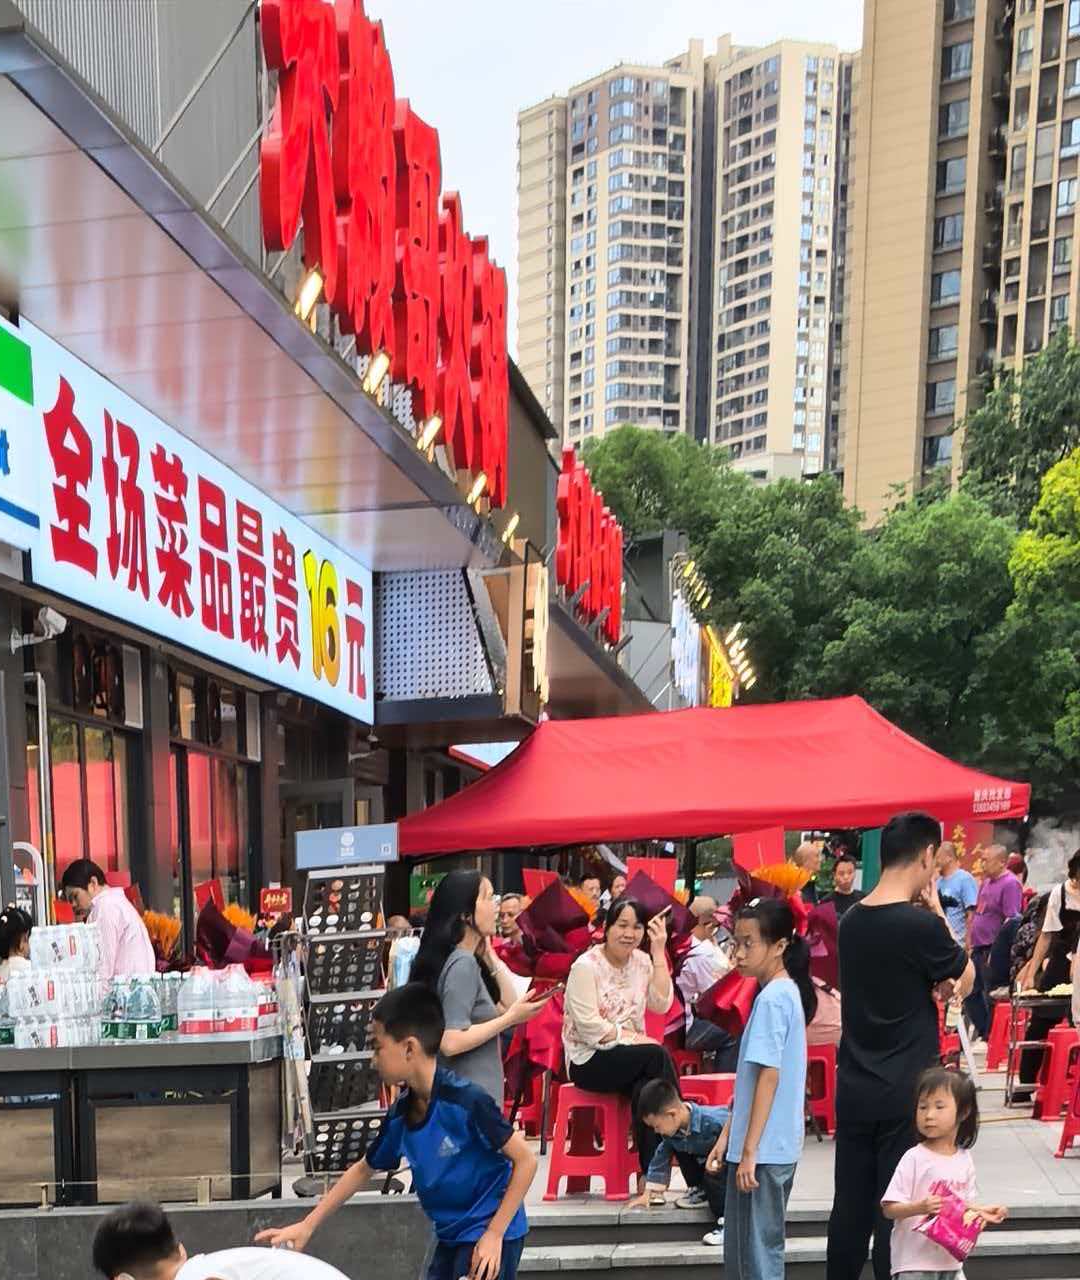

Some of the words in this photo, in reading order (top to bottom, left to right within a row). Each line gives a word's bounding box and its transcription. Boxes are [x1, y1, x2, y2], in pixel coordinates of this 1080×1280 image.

[43, 374, 366, 700] 全场菜品最贵16元
